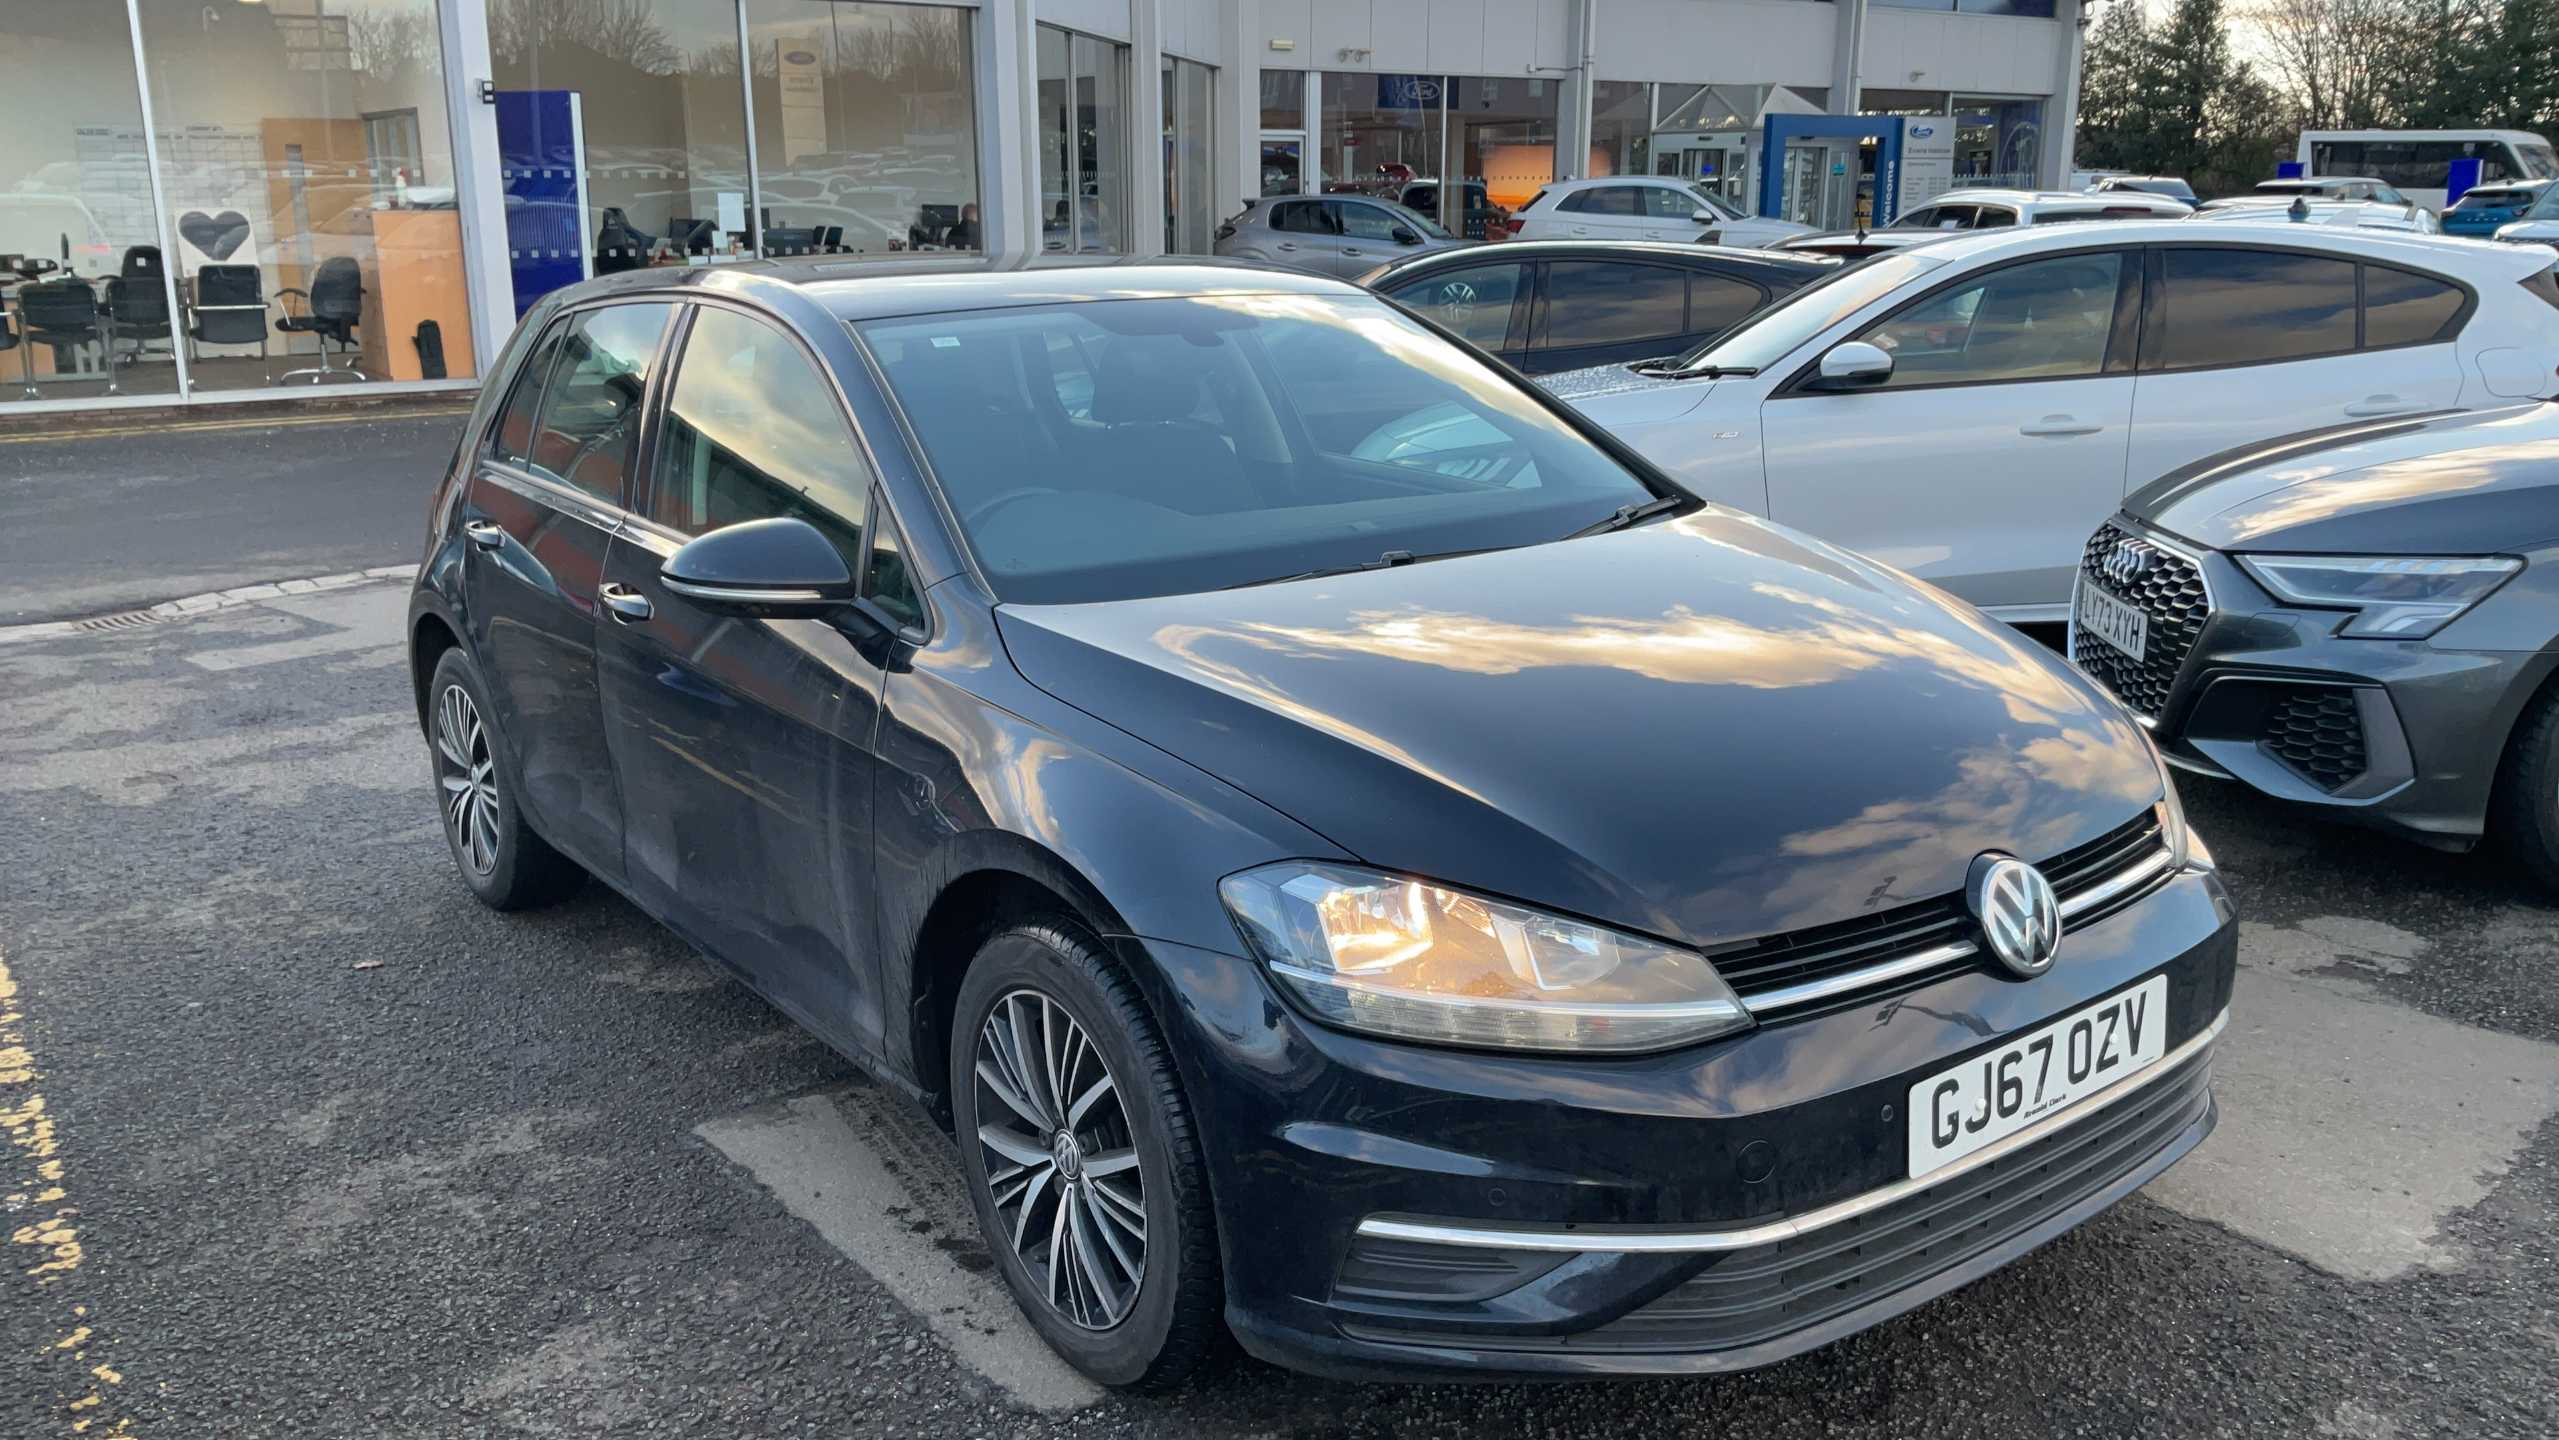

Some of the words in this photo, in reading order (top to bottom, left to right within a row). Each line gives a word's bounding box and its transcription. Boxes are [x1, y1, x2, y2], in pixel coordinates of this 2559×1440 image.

[2084, 589, 2112, 634] LY73
[2113, 606, 2141, 652] XYH
[1931, 1033, 2054, 1150] GJ67
[2067, 991, 2147, 1086] OZV
